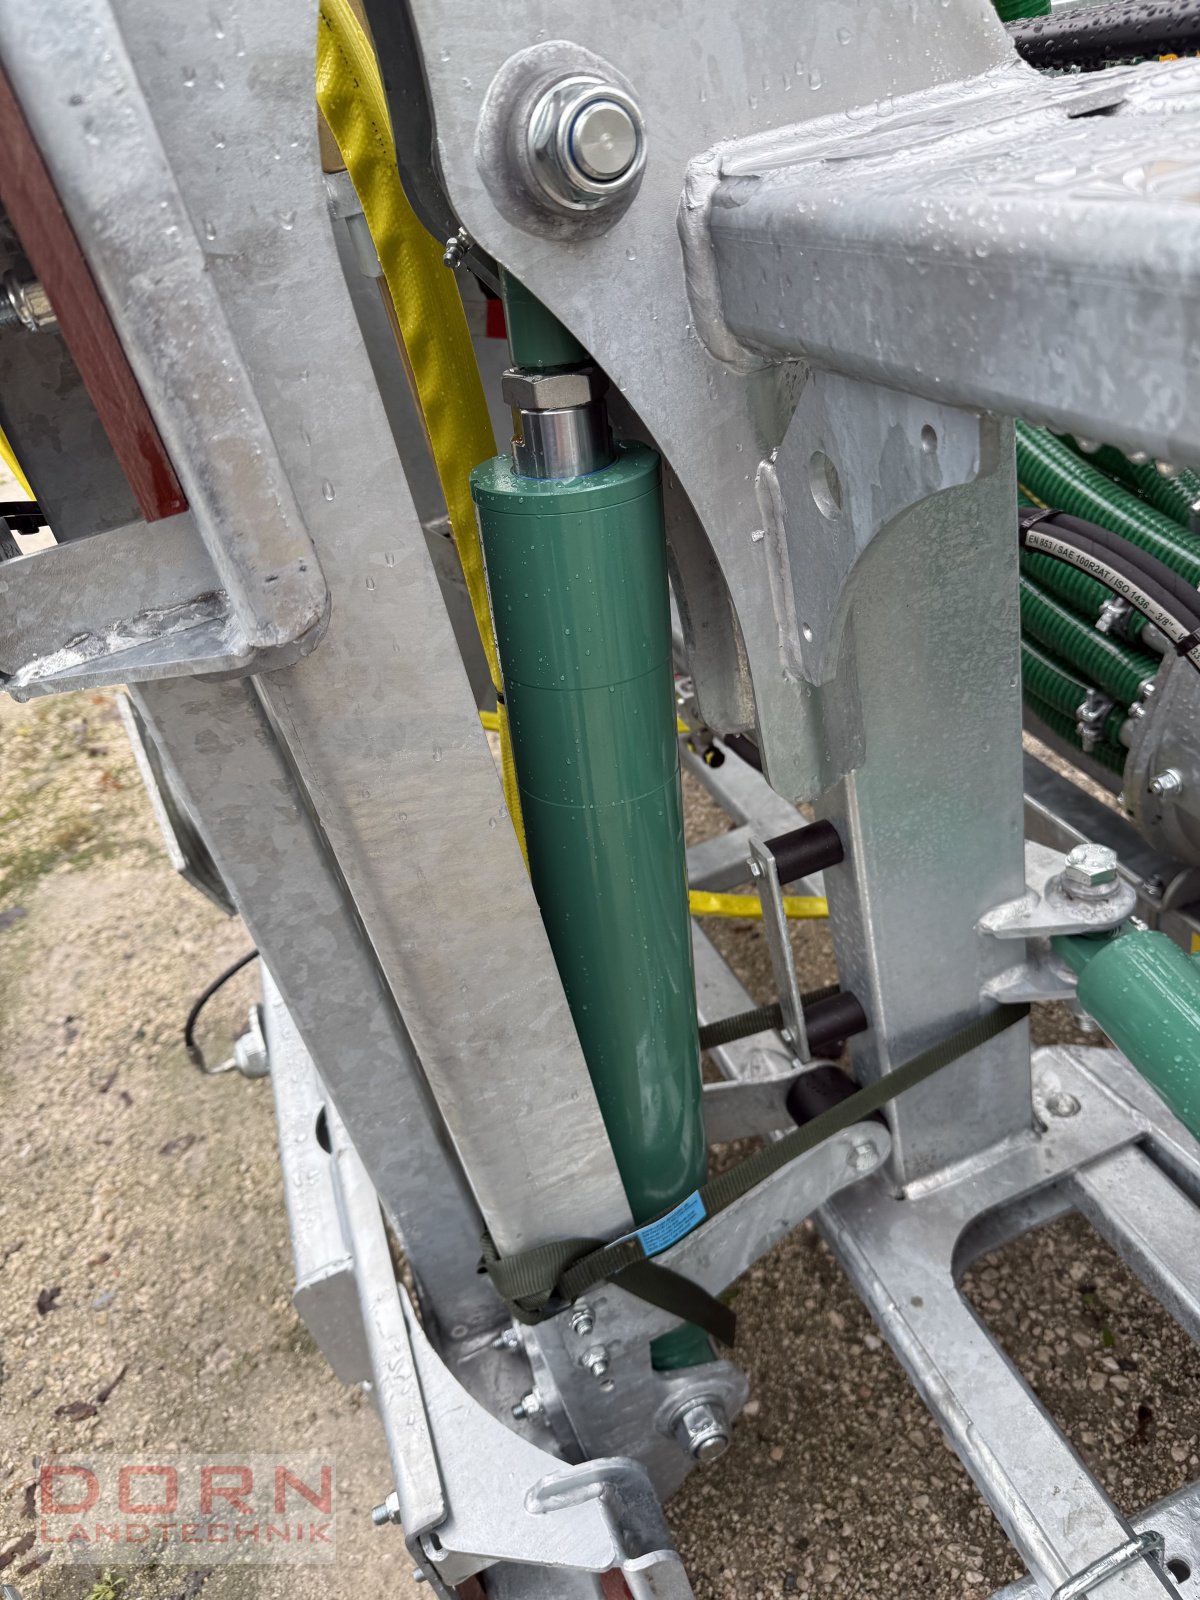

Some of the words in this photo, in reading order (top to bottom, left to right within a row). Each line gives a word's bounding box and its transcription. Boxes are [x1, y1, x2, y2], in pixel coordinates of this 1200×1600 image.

[1028, 535, 1039, 544] EN
[1040, 538, 1053, 550] 853
[1057, 545, 1075, 559] SAE
[1076, 554, 1110, 578] 100R2AT
[1114, 578, 1130, 594] ISO
[1130, 591, 1150, 609] 1436
